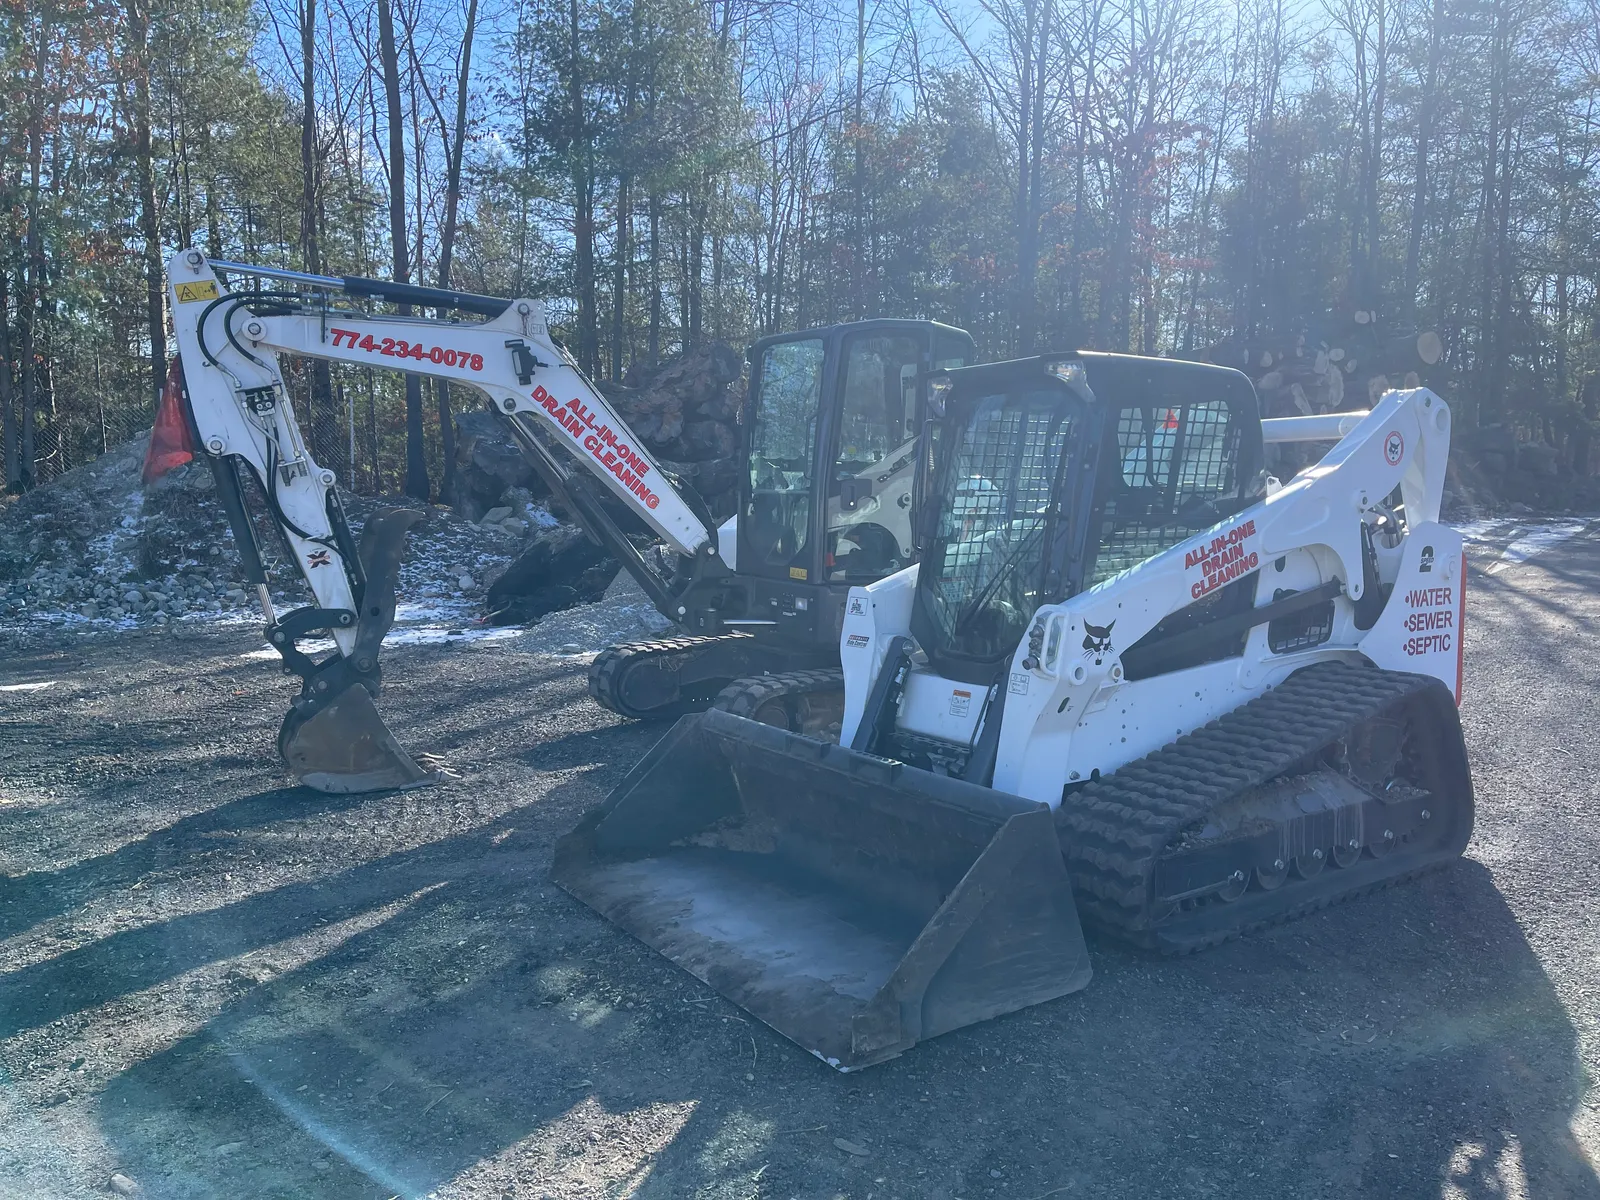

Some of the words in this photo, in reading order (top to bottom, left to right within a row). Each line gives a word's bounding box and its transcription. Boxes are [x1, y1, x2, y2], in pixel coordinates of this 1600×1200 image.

[331, 328, 484, 371] 774-234-0078
[531, 385, 585, 439] DRAIN
[584, 435, 660, 509] CLEANING
[565, 397, 650, 478] ALL-IN-ONE
[1185, 519, 1256, 570] ALL-IN-ONE
[1201, 542, 1244, 577] DRAIN
[1419, 545, 1434, 572] 2
[1191, 552, 1259, 599] CLEANING
